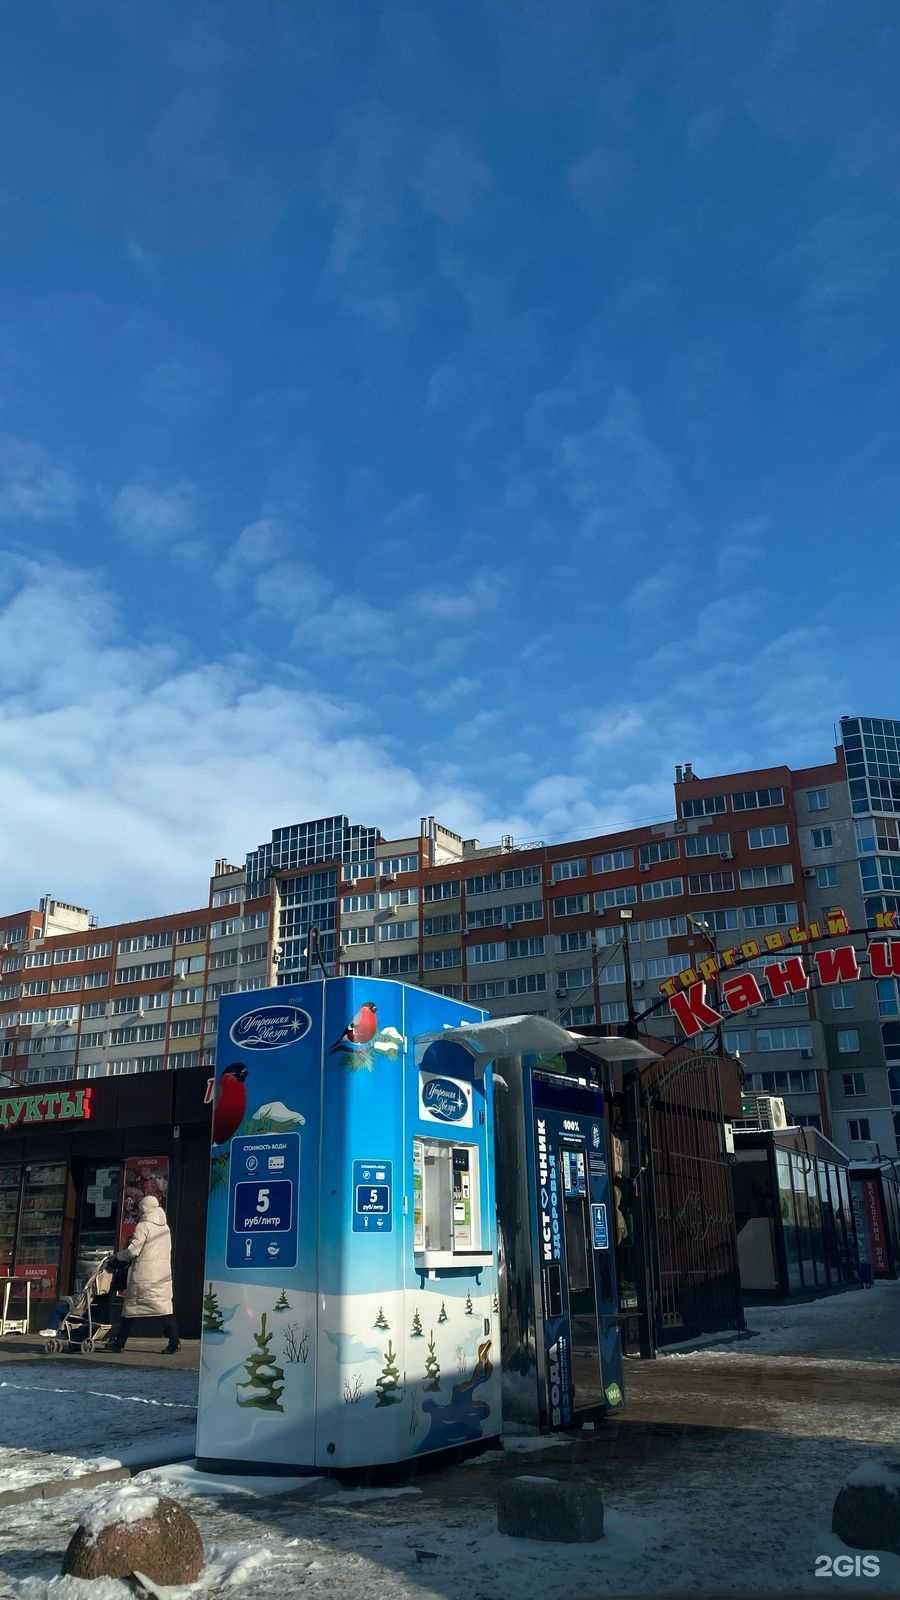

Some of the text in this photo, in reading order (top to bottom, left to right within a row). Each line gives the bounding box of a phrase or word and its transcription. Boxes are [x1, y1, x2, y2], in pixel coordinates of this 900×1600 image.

[256, 1188, 270, 1213] 5
[370, 1189, 378, 1203] 5
[362, 1204, 384, 1212] руб/литр
[244, 1216, 281, 1228] руб/литр
[549, 1342, 561, 1426] ВОДА
